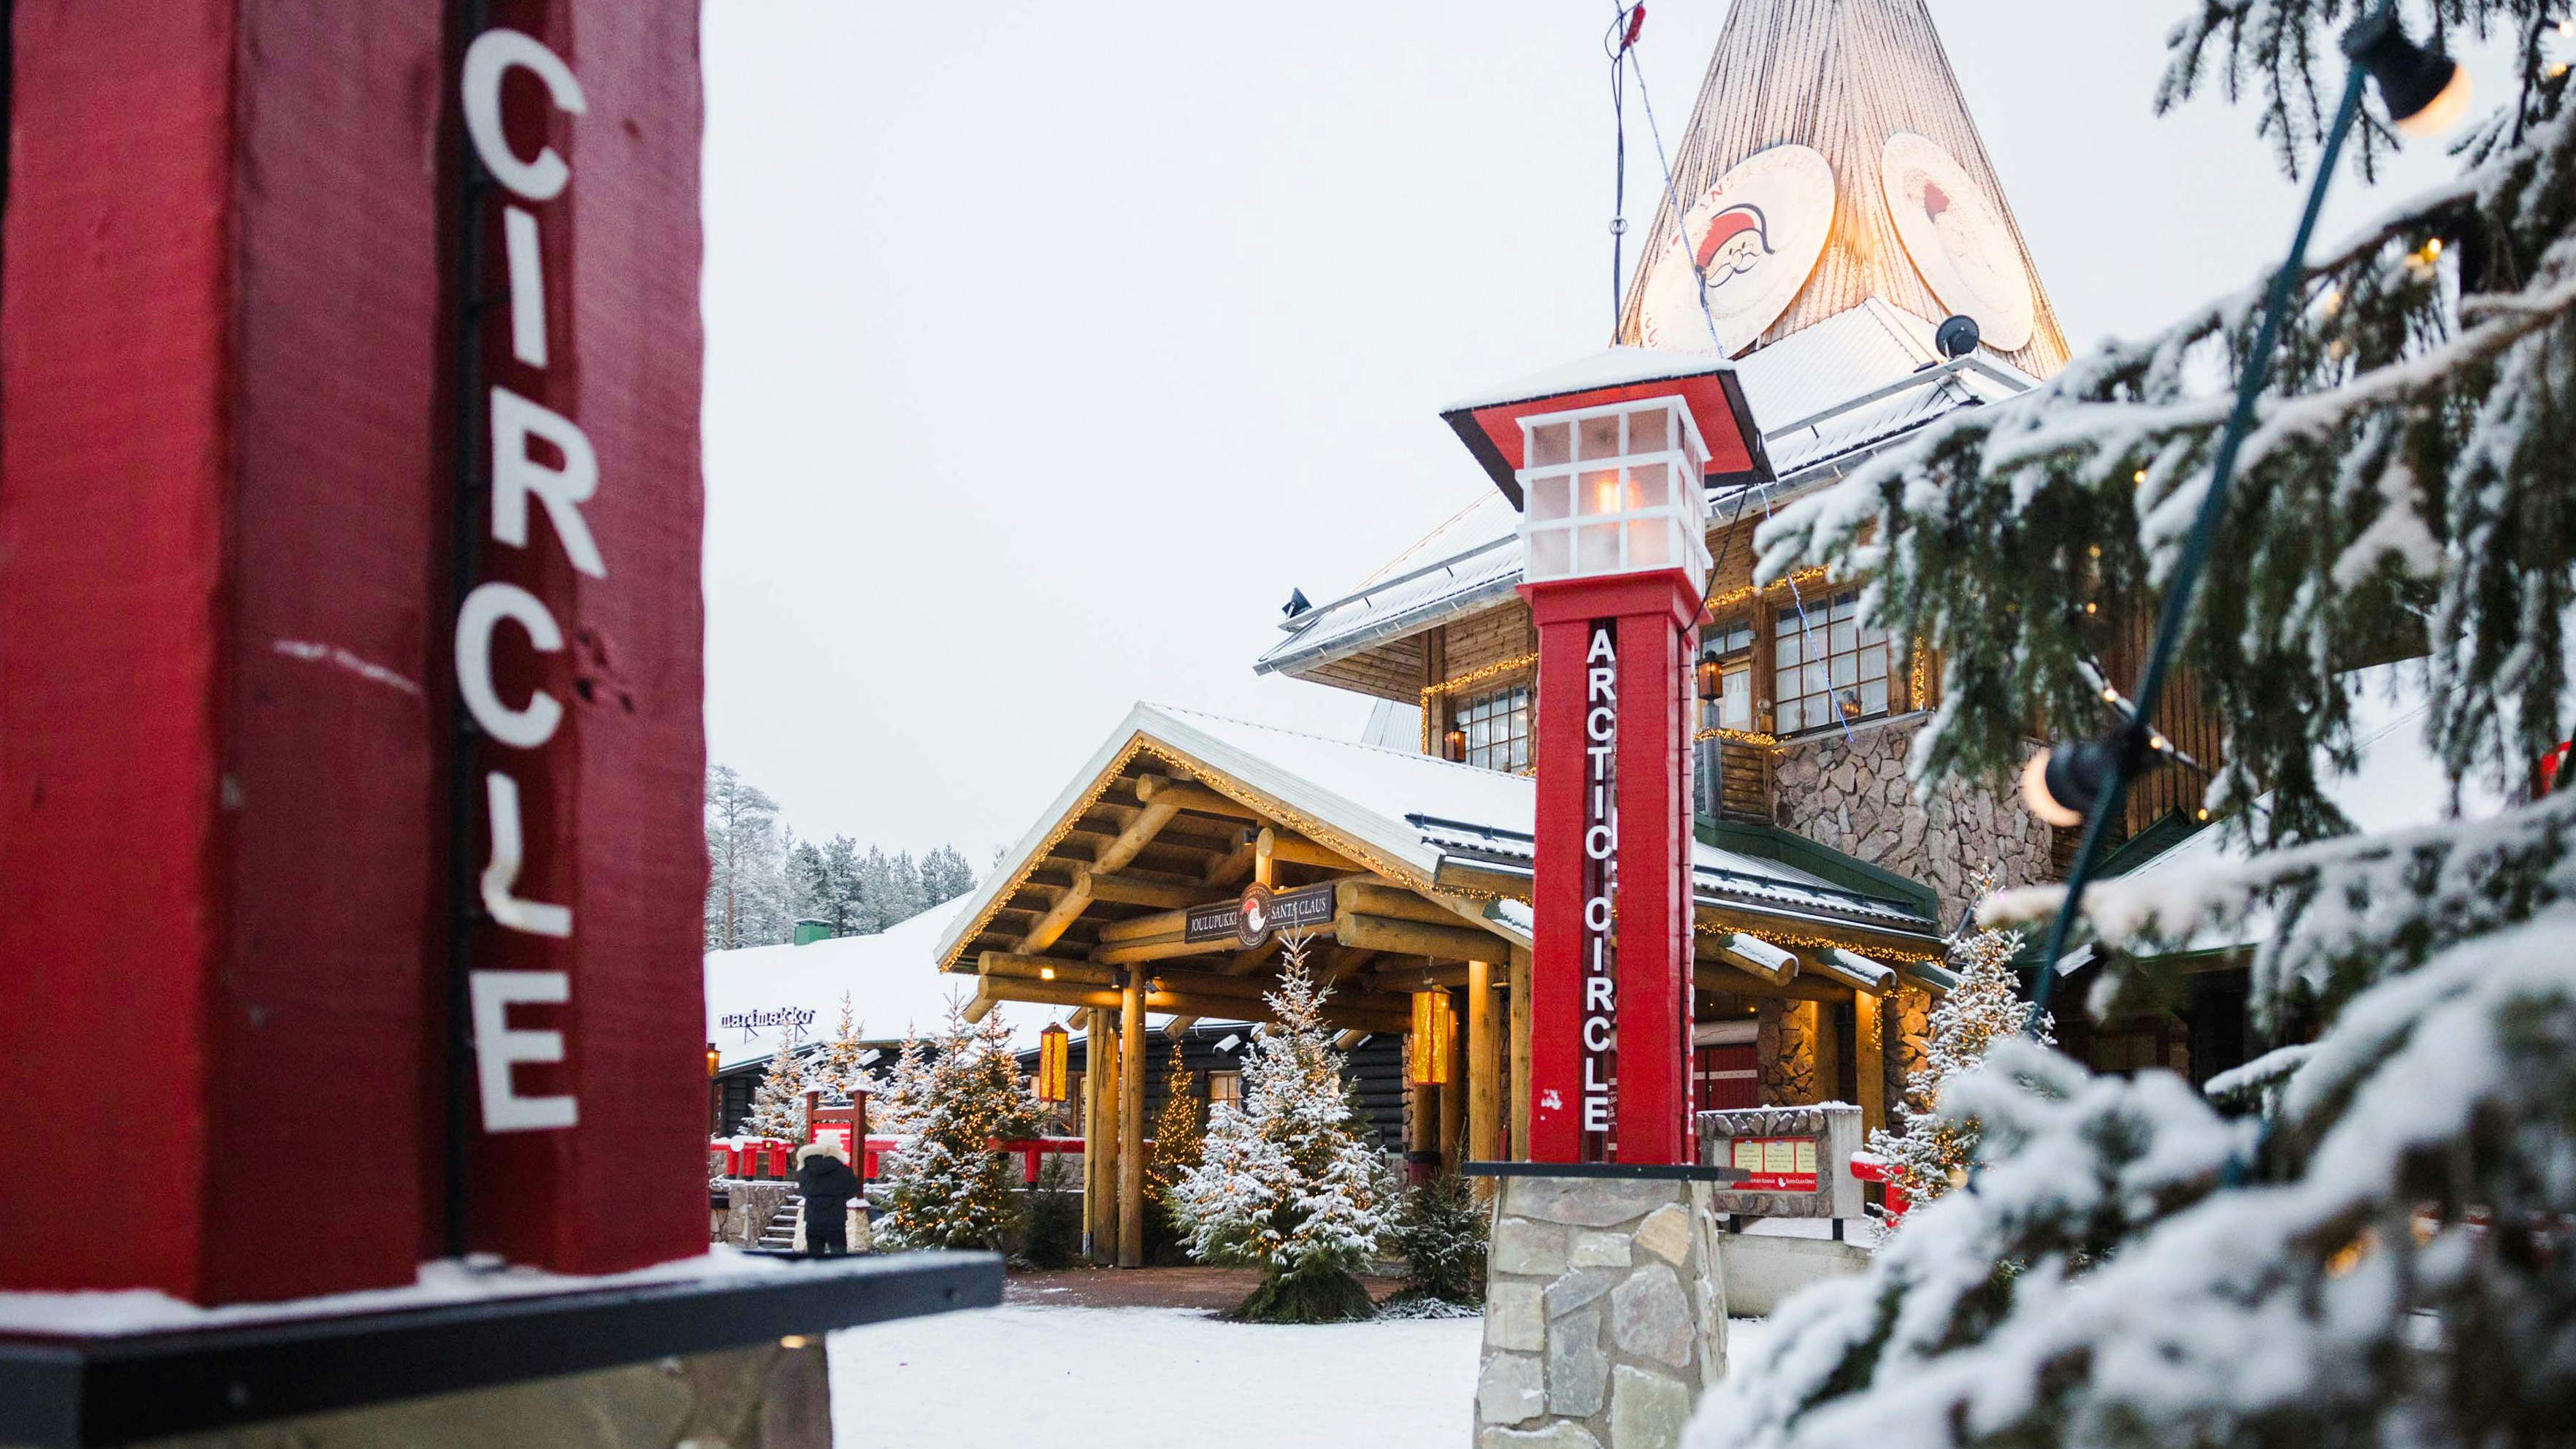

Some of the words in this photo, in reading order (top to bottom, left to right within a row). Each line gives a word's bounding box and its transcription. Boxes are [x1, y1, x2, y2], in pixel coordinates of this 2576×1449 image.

[455, 28, 607, 1134] CIRCLE
[1585, 628, 1616, 861] ARCTIC
[1191, 911, 1238, 933] JOULUPUKKI
[1270, 902, 1298, 920] SANTA
[1299, 898, 1326, 915] CLAUS
[719, 1006, 814, 1028] marimekko
[1584, 896, 1614, 1132] CIRCLE
